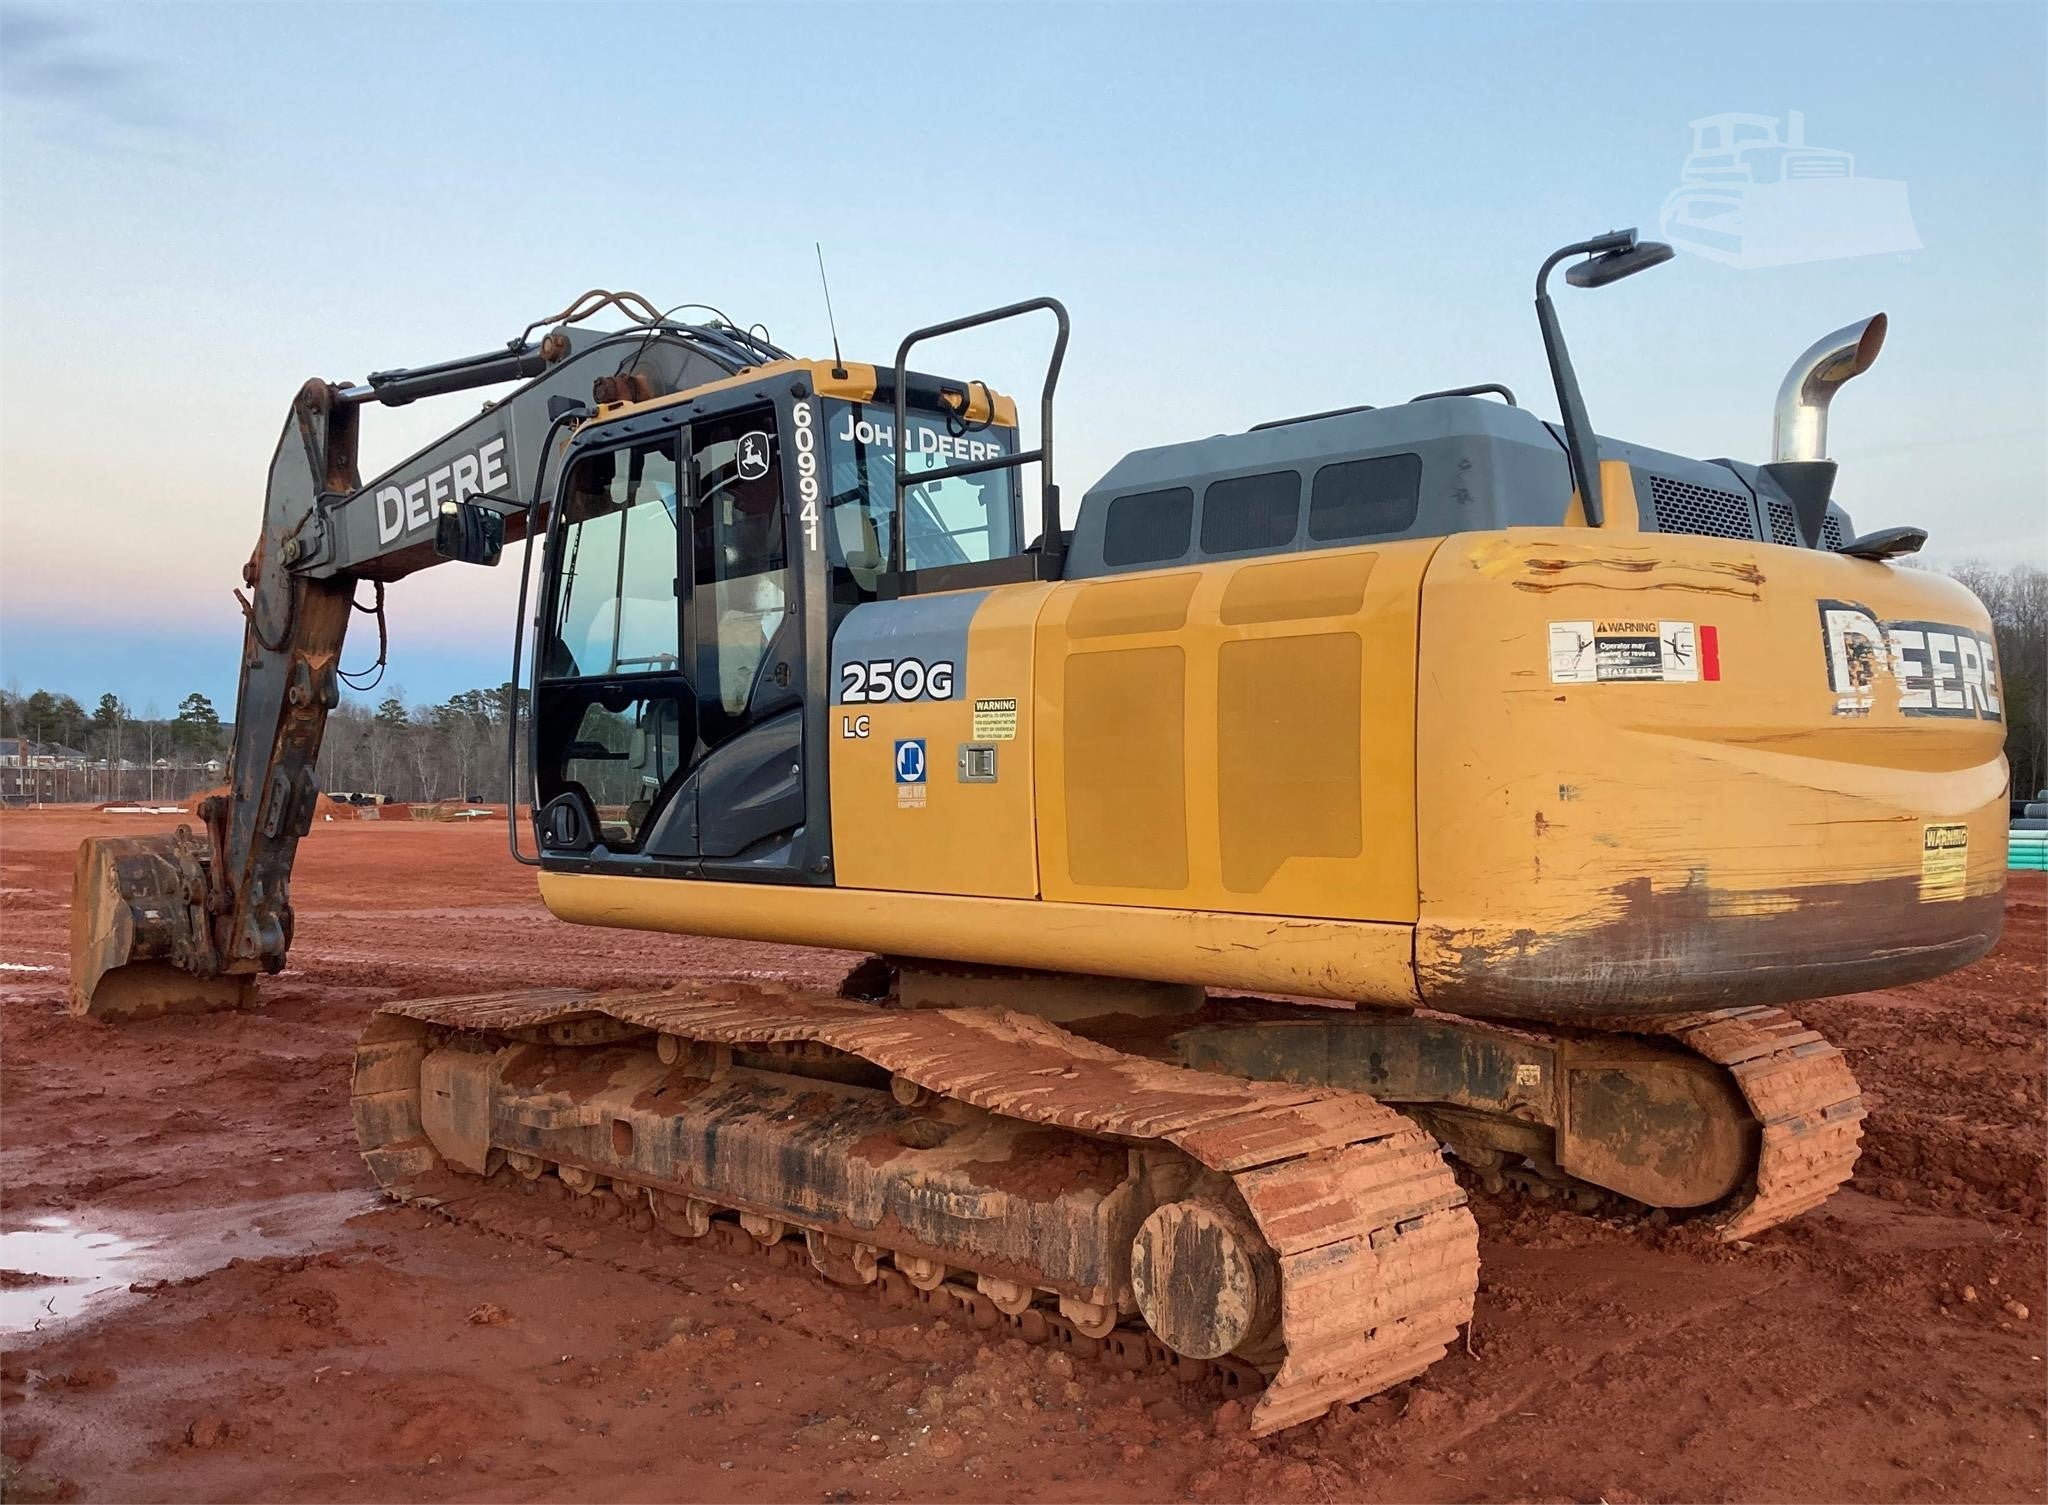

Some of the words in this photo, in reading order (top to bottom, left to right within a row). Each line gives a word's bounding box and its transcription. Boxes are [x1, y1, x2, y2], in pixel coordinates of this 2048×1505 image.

[918, 426, 1001, 461] DEERE
[792, 402, 819, 551] 609941
[1608, 622, 1656, 632] WARNING
[1600, 642, 1630, 650] Operator
[1818, 600, 2001, 718] DEERE
[841, 658, 953, 704] 250G
[976, 700, 1015, 710] WARNING
[843, 716, 869, 738] LC
